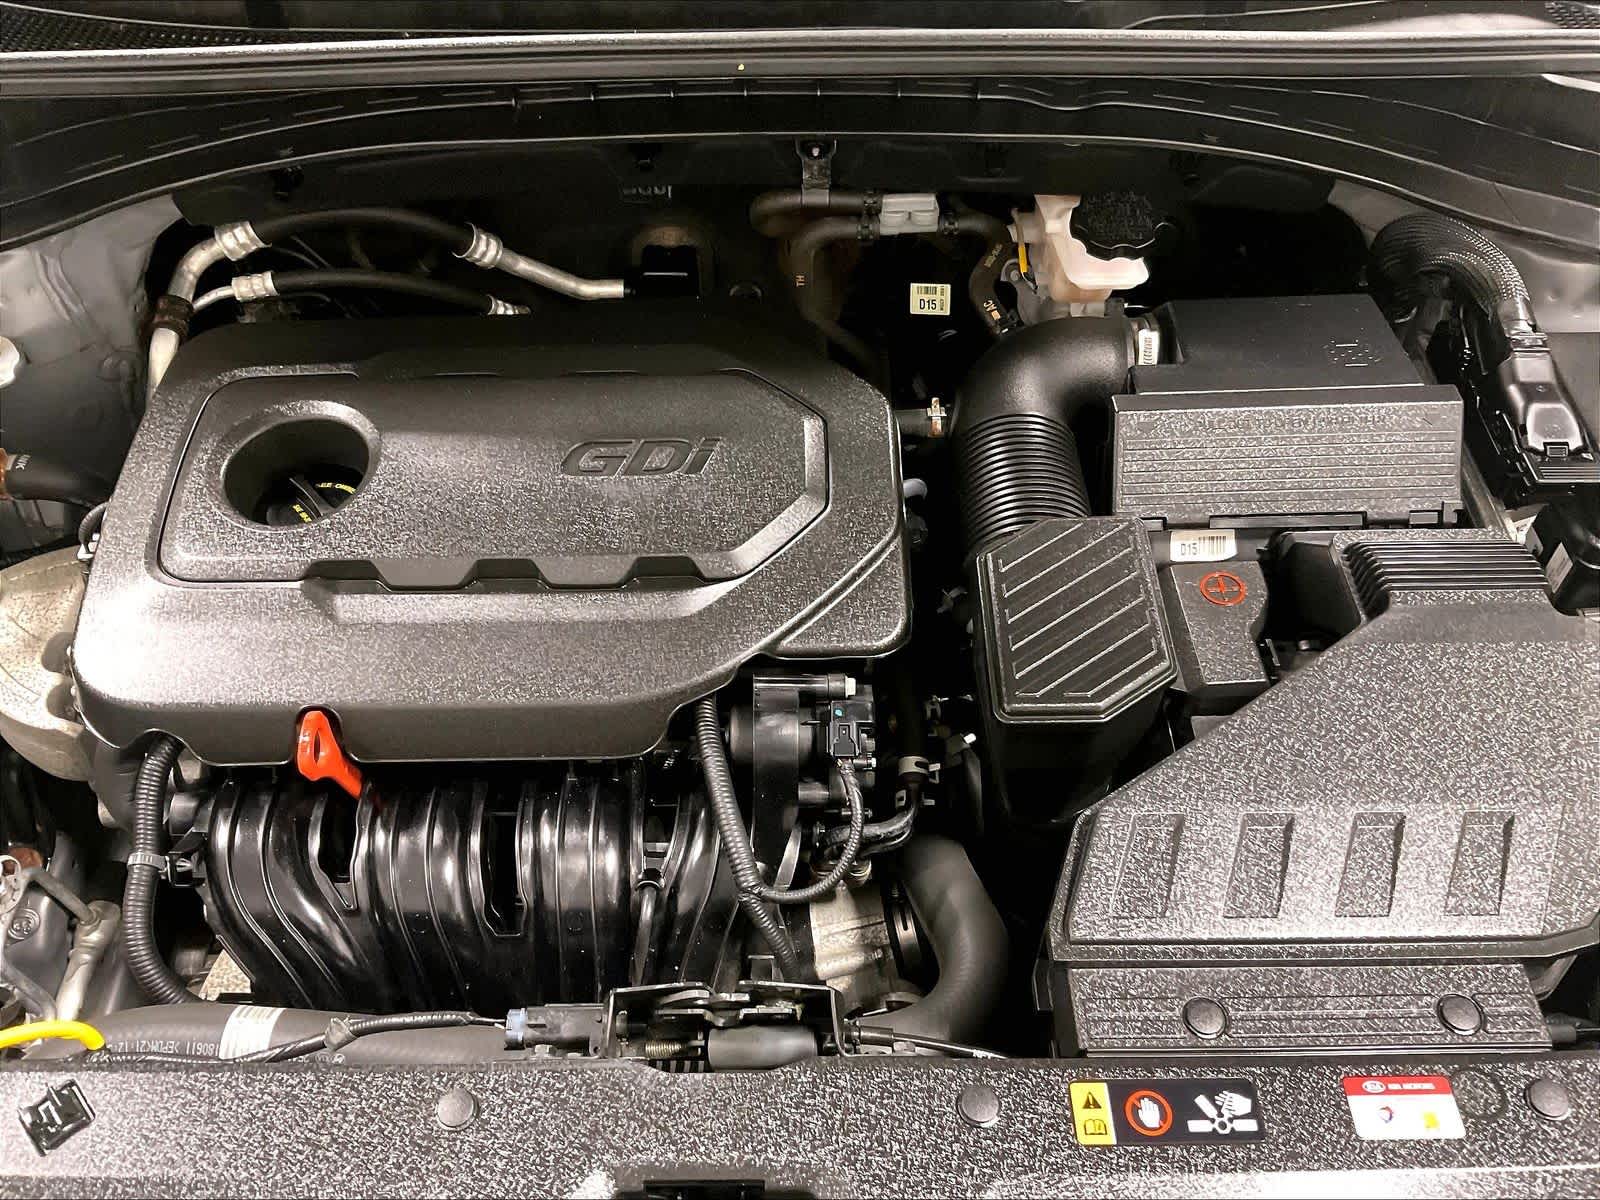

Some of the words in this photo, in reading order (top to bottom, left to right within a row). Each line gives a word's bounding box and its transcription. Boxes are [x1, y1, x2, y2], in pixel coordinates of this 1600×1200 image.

[919, 298, 937, 310] D15
[560, 436, 721, 476] GDi
[1180, 543, 1198, 556] D15
